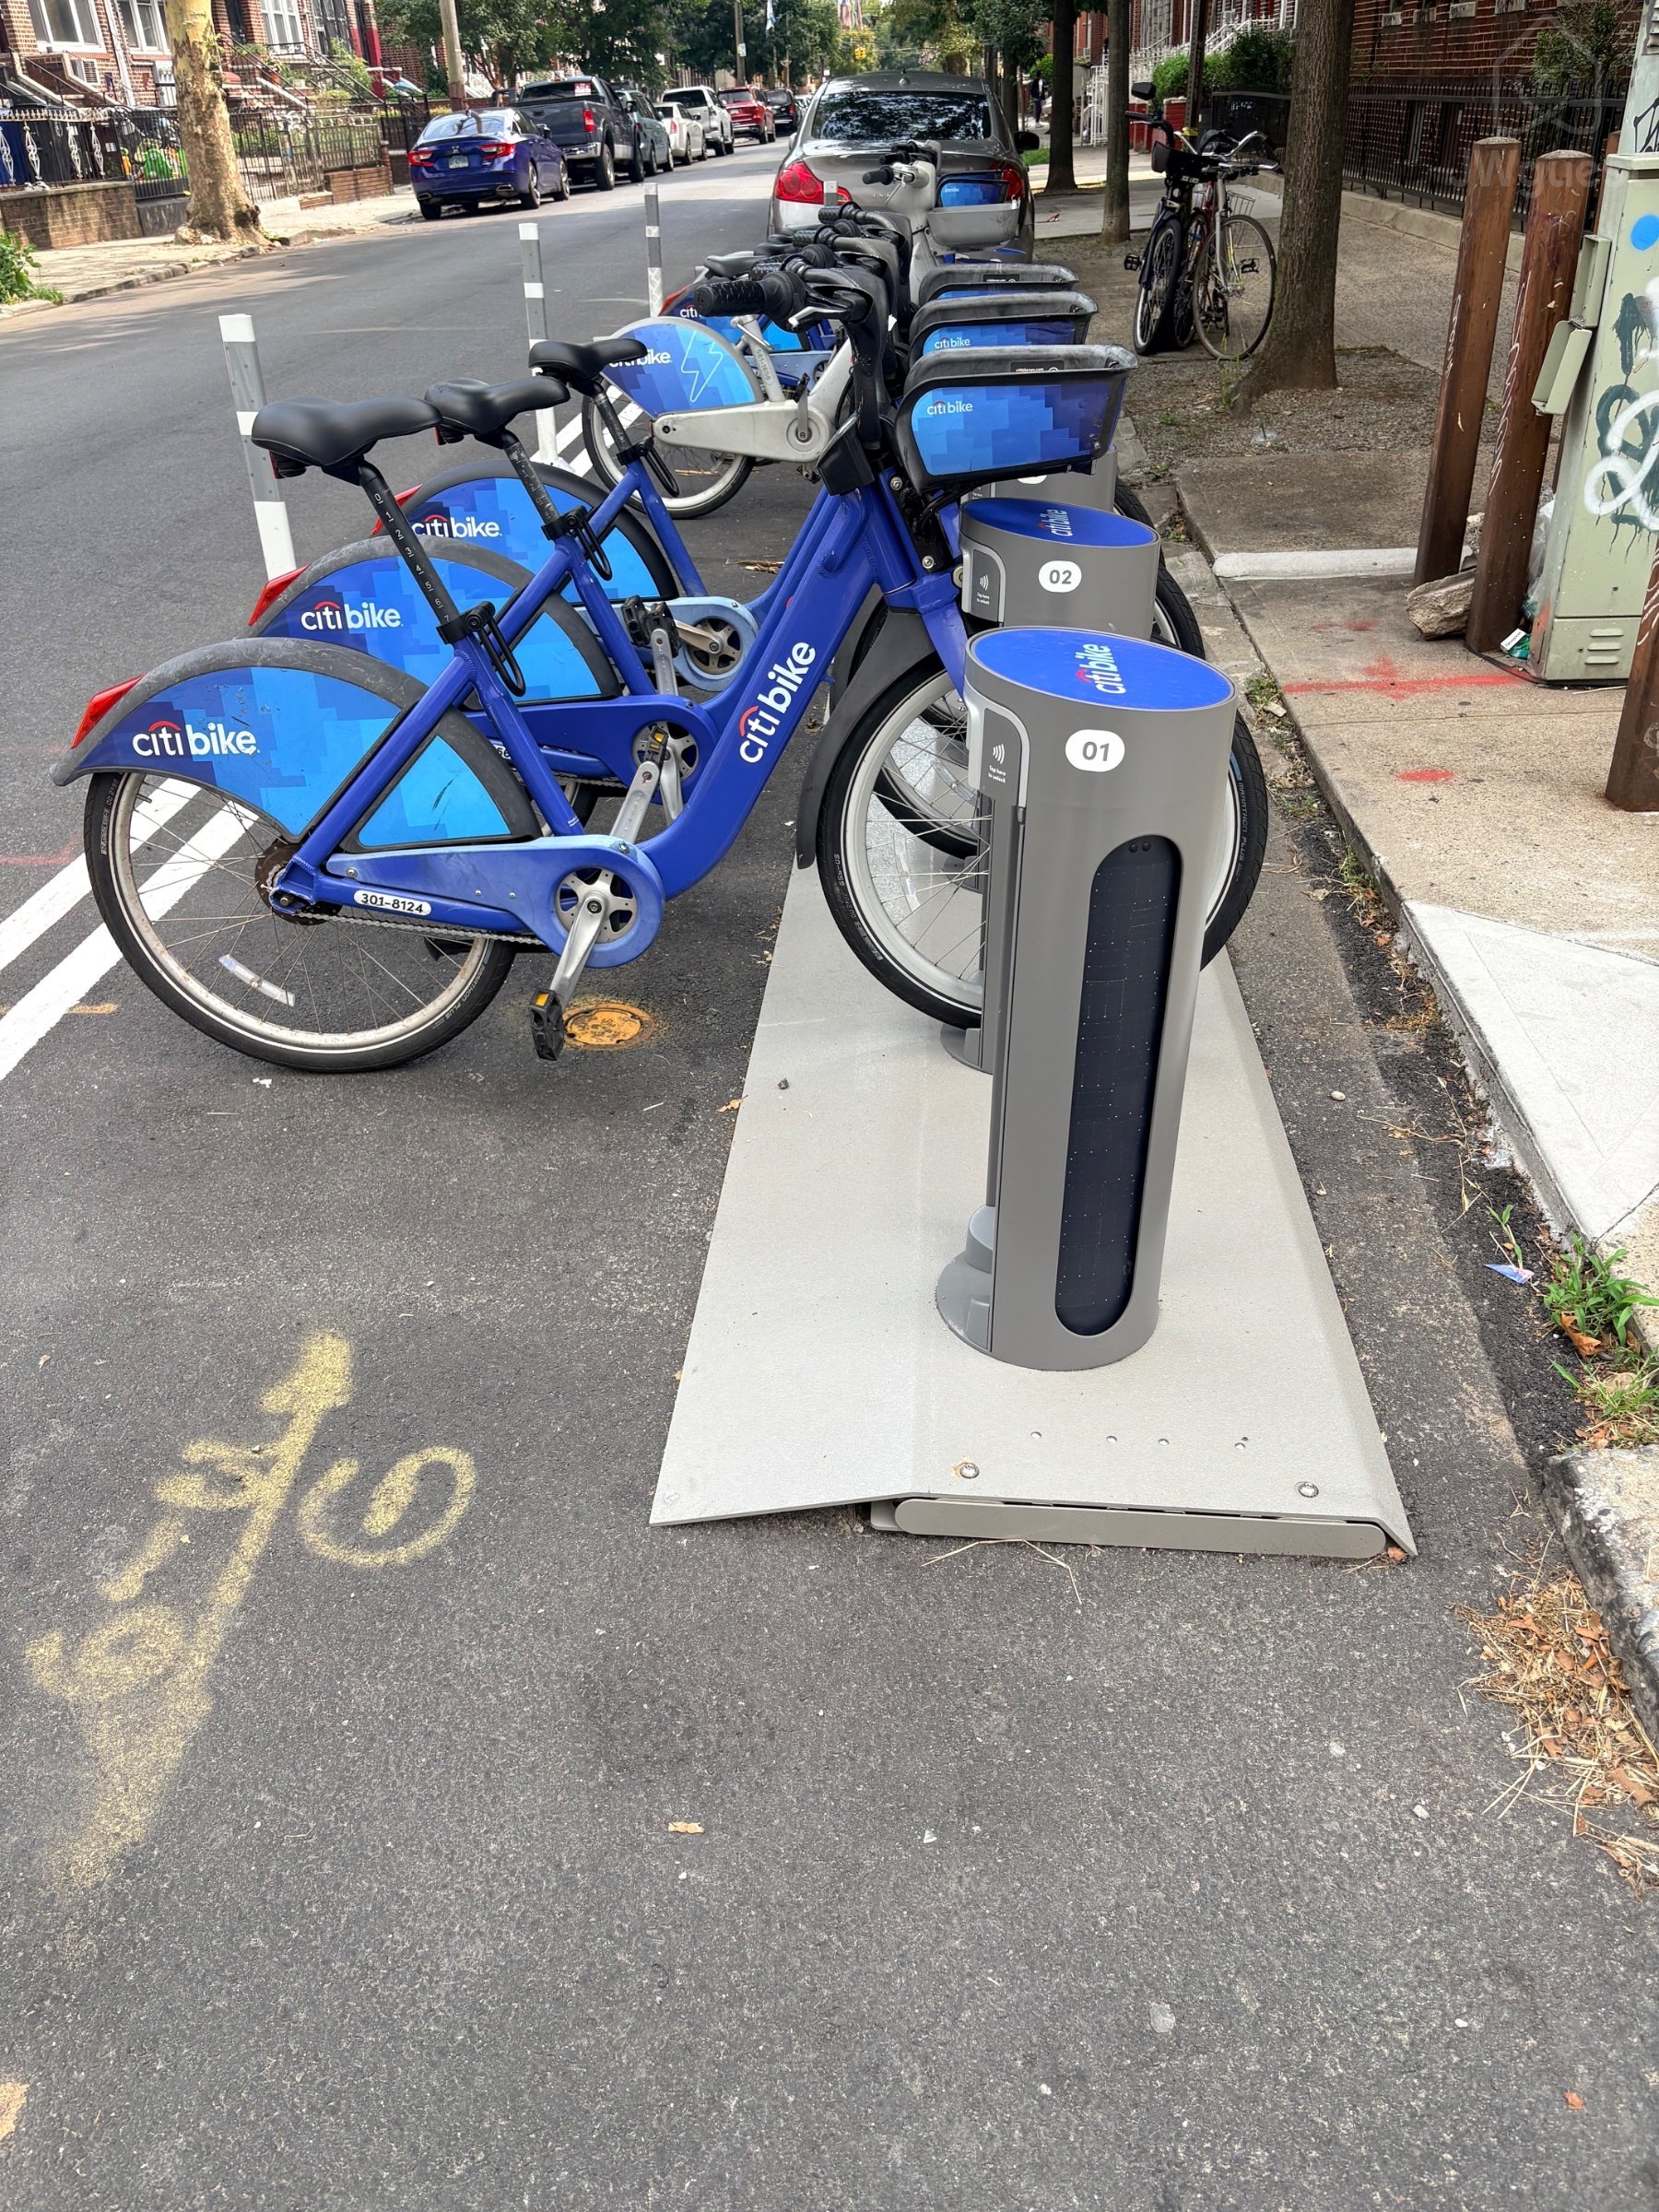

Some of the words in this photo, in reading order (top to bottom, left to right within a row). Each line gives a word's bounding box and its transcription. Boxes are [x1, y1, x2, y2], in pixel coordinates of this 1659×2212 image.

[1049, 570, 1072, 585] 02
[1082, 741, 1111, 762] 01
[360, 893, 424, 913] 301-8124
